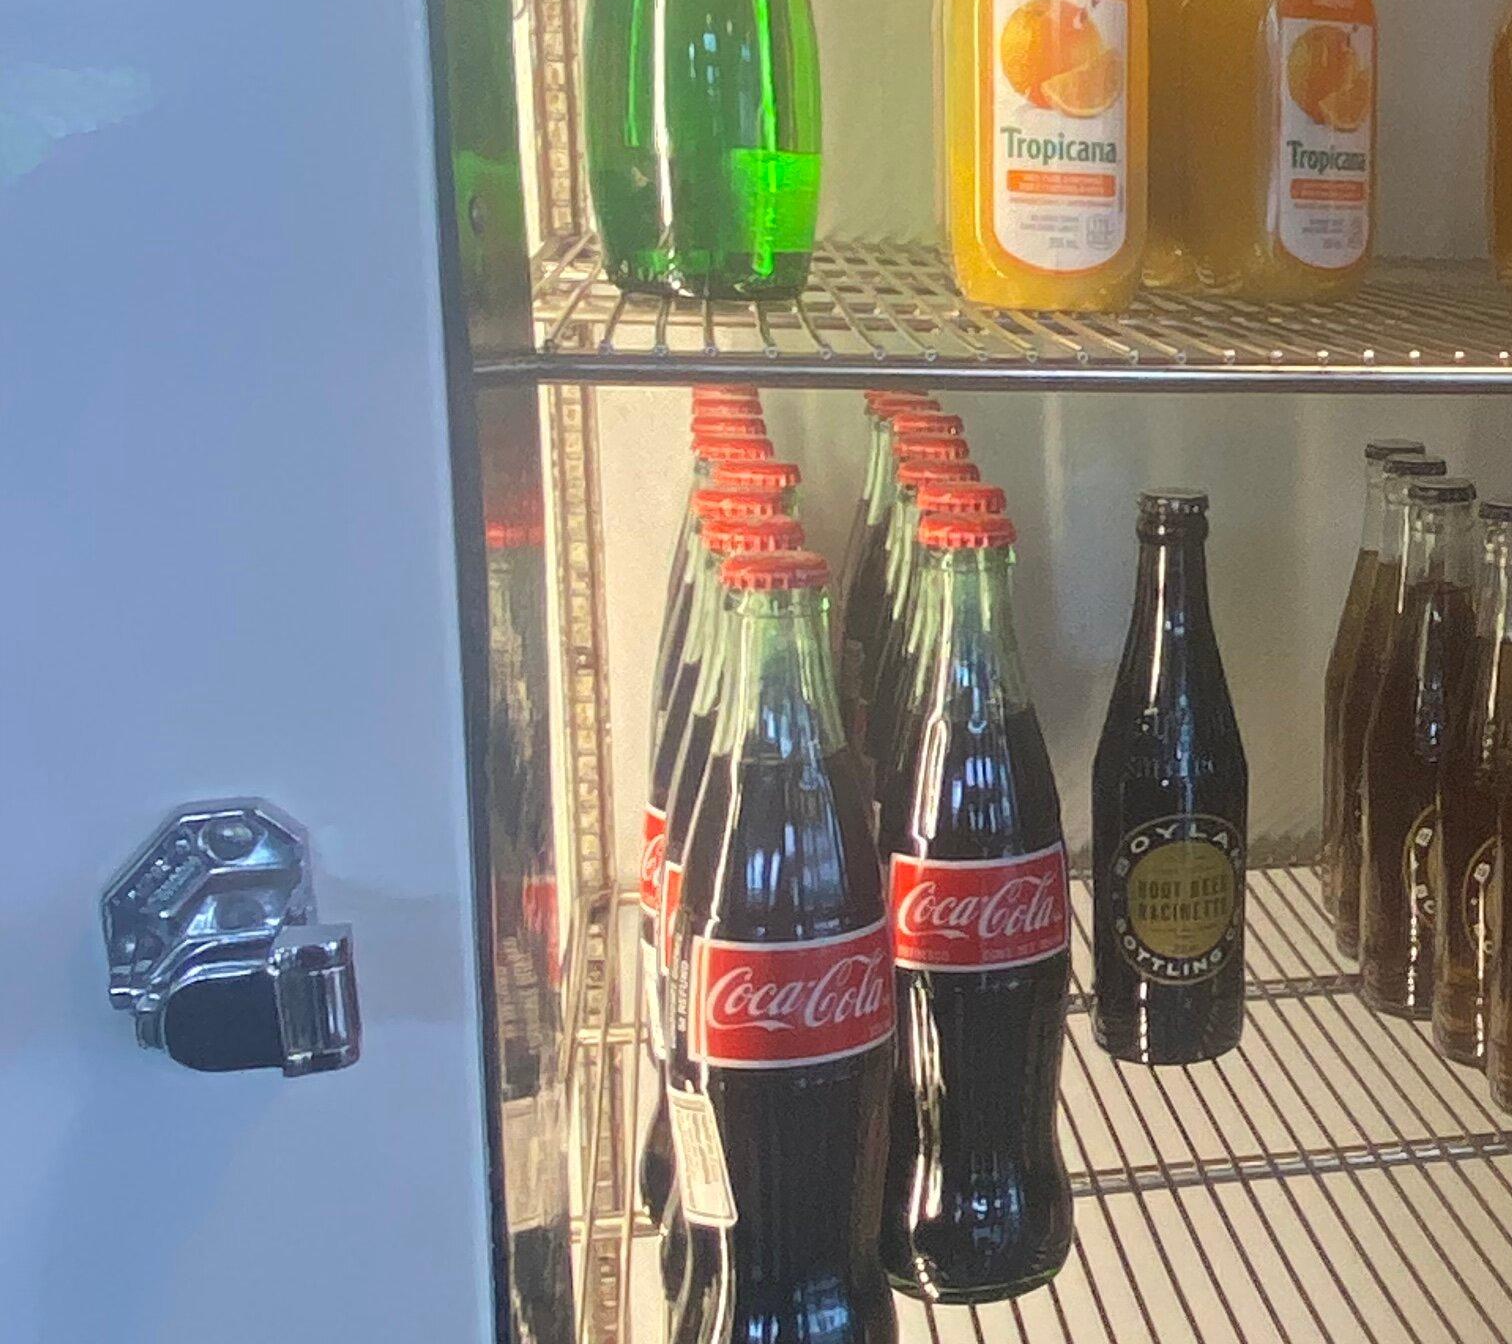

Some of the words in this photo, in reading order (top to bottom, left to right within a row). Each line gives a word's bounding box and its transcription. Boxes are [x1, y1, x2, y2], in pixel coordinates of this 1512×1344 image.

[1000, 126, 1117, 165] Tropicana
[1287, 140, 1366, 175] Tropicana
[897, 870, 1057, 939] Coca-Cola
[707, 949, 886, 1032] Coca-Cola
